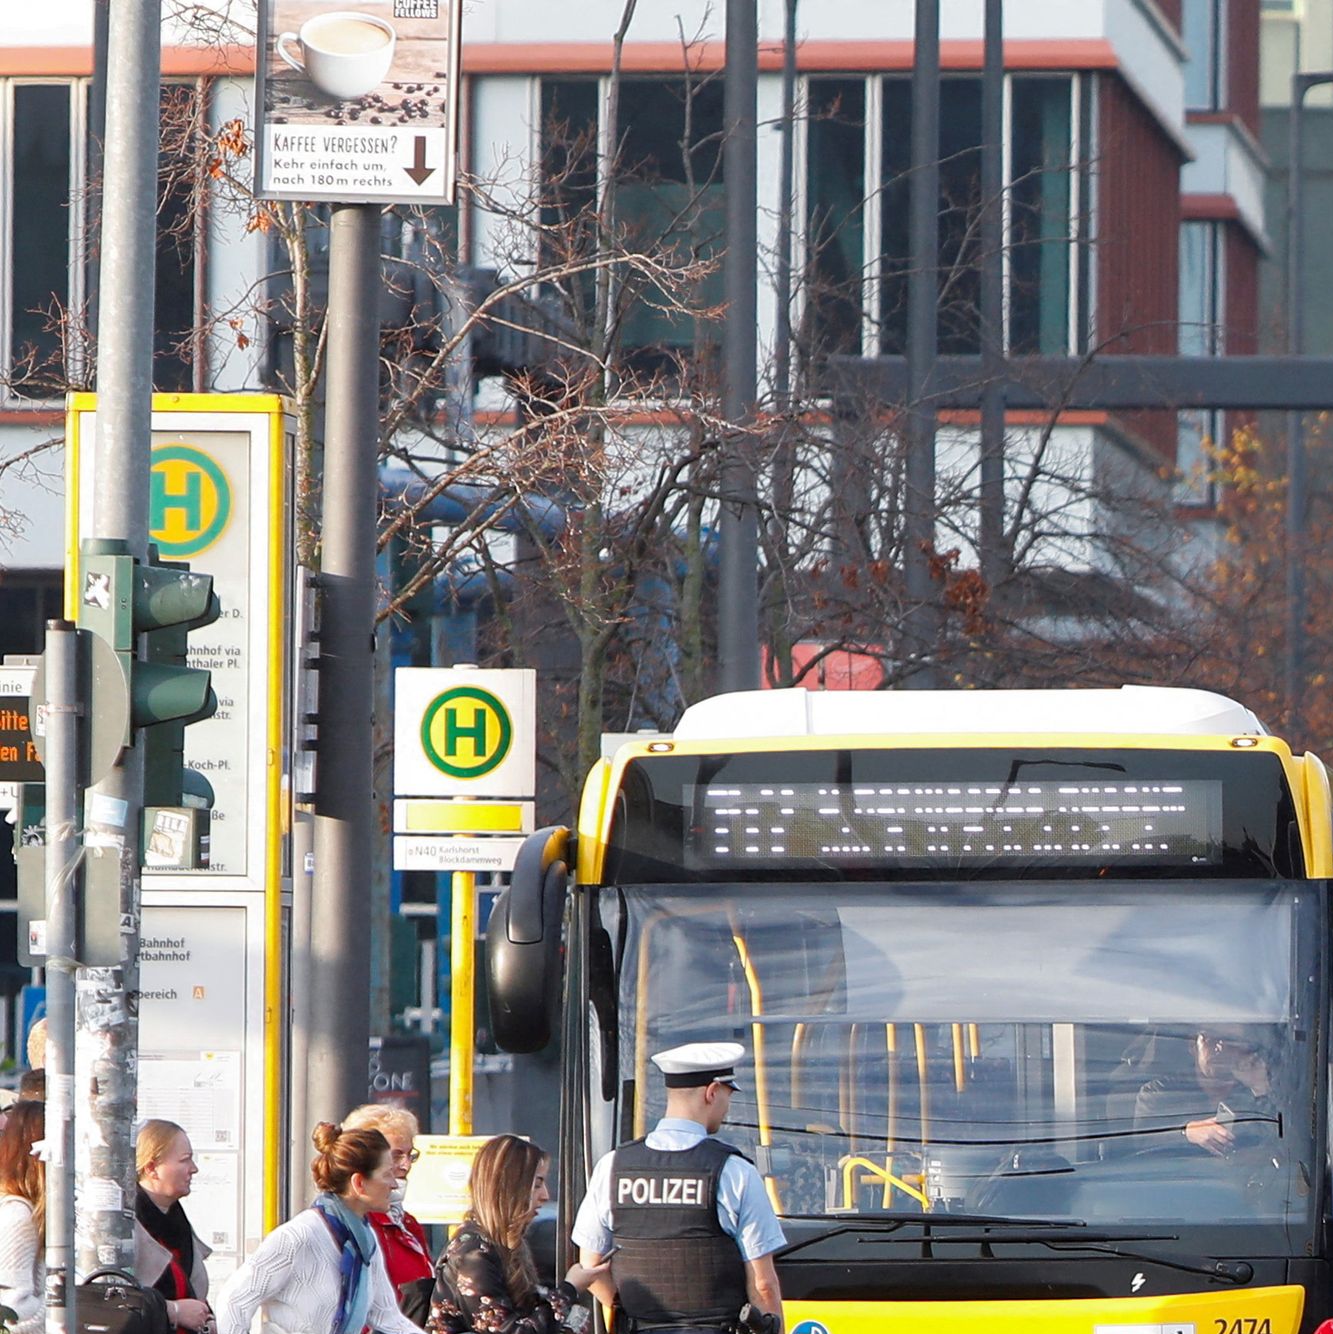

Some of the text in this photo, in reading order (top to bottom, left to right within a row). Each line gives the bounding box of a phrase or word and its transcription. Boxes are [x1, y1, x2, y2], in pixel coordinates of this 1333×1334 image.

[395, 8, 438, 18] FELLOWS
[274, 133, 397, 154] KAFFEE VERGESSEN?
[274, 158, 387, 173] Kehr einfach um,
[273, 174, 304, 185] nach
[353, 176, 392, 187] rechts
[225, 646, 241, 656] via
[227, 658, 240, 668] Pl.
[219, 697, 234, 706] via
[445, 708, 486, 757] H
[211, 810, 225, 820] ße
[618, 1177, 703, 1204] POLIZEI
